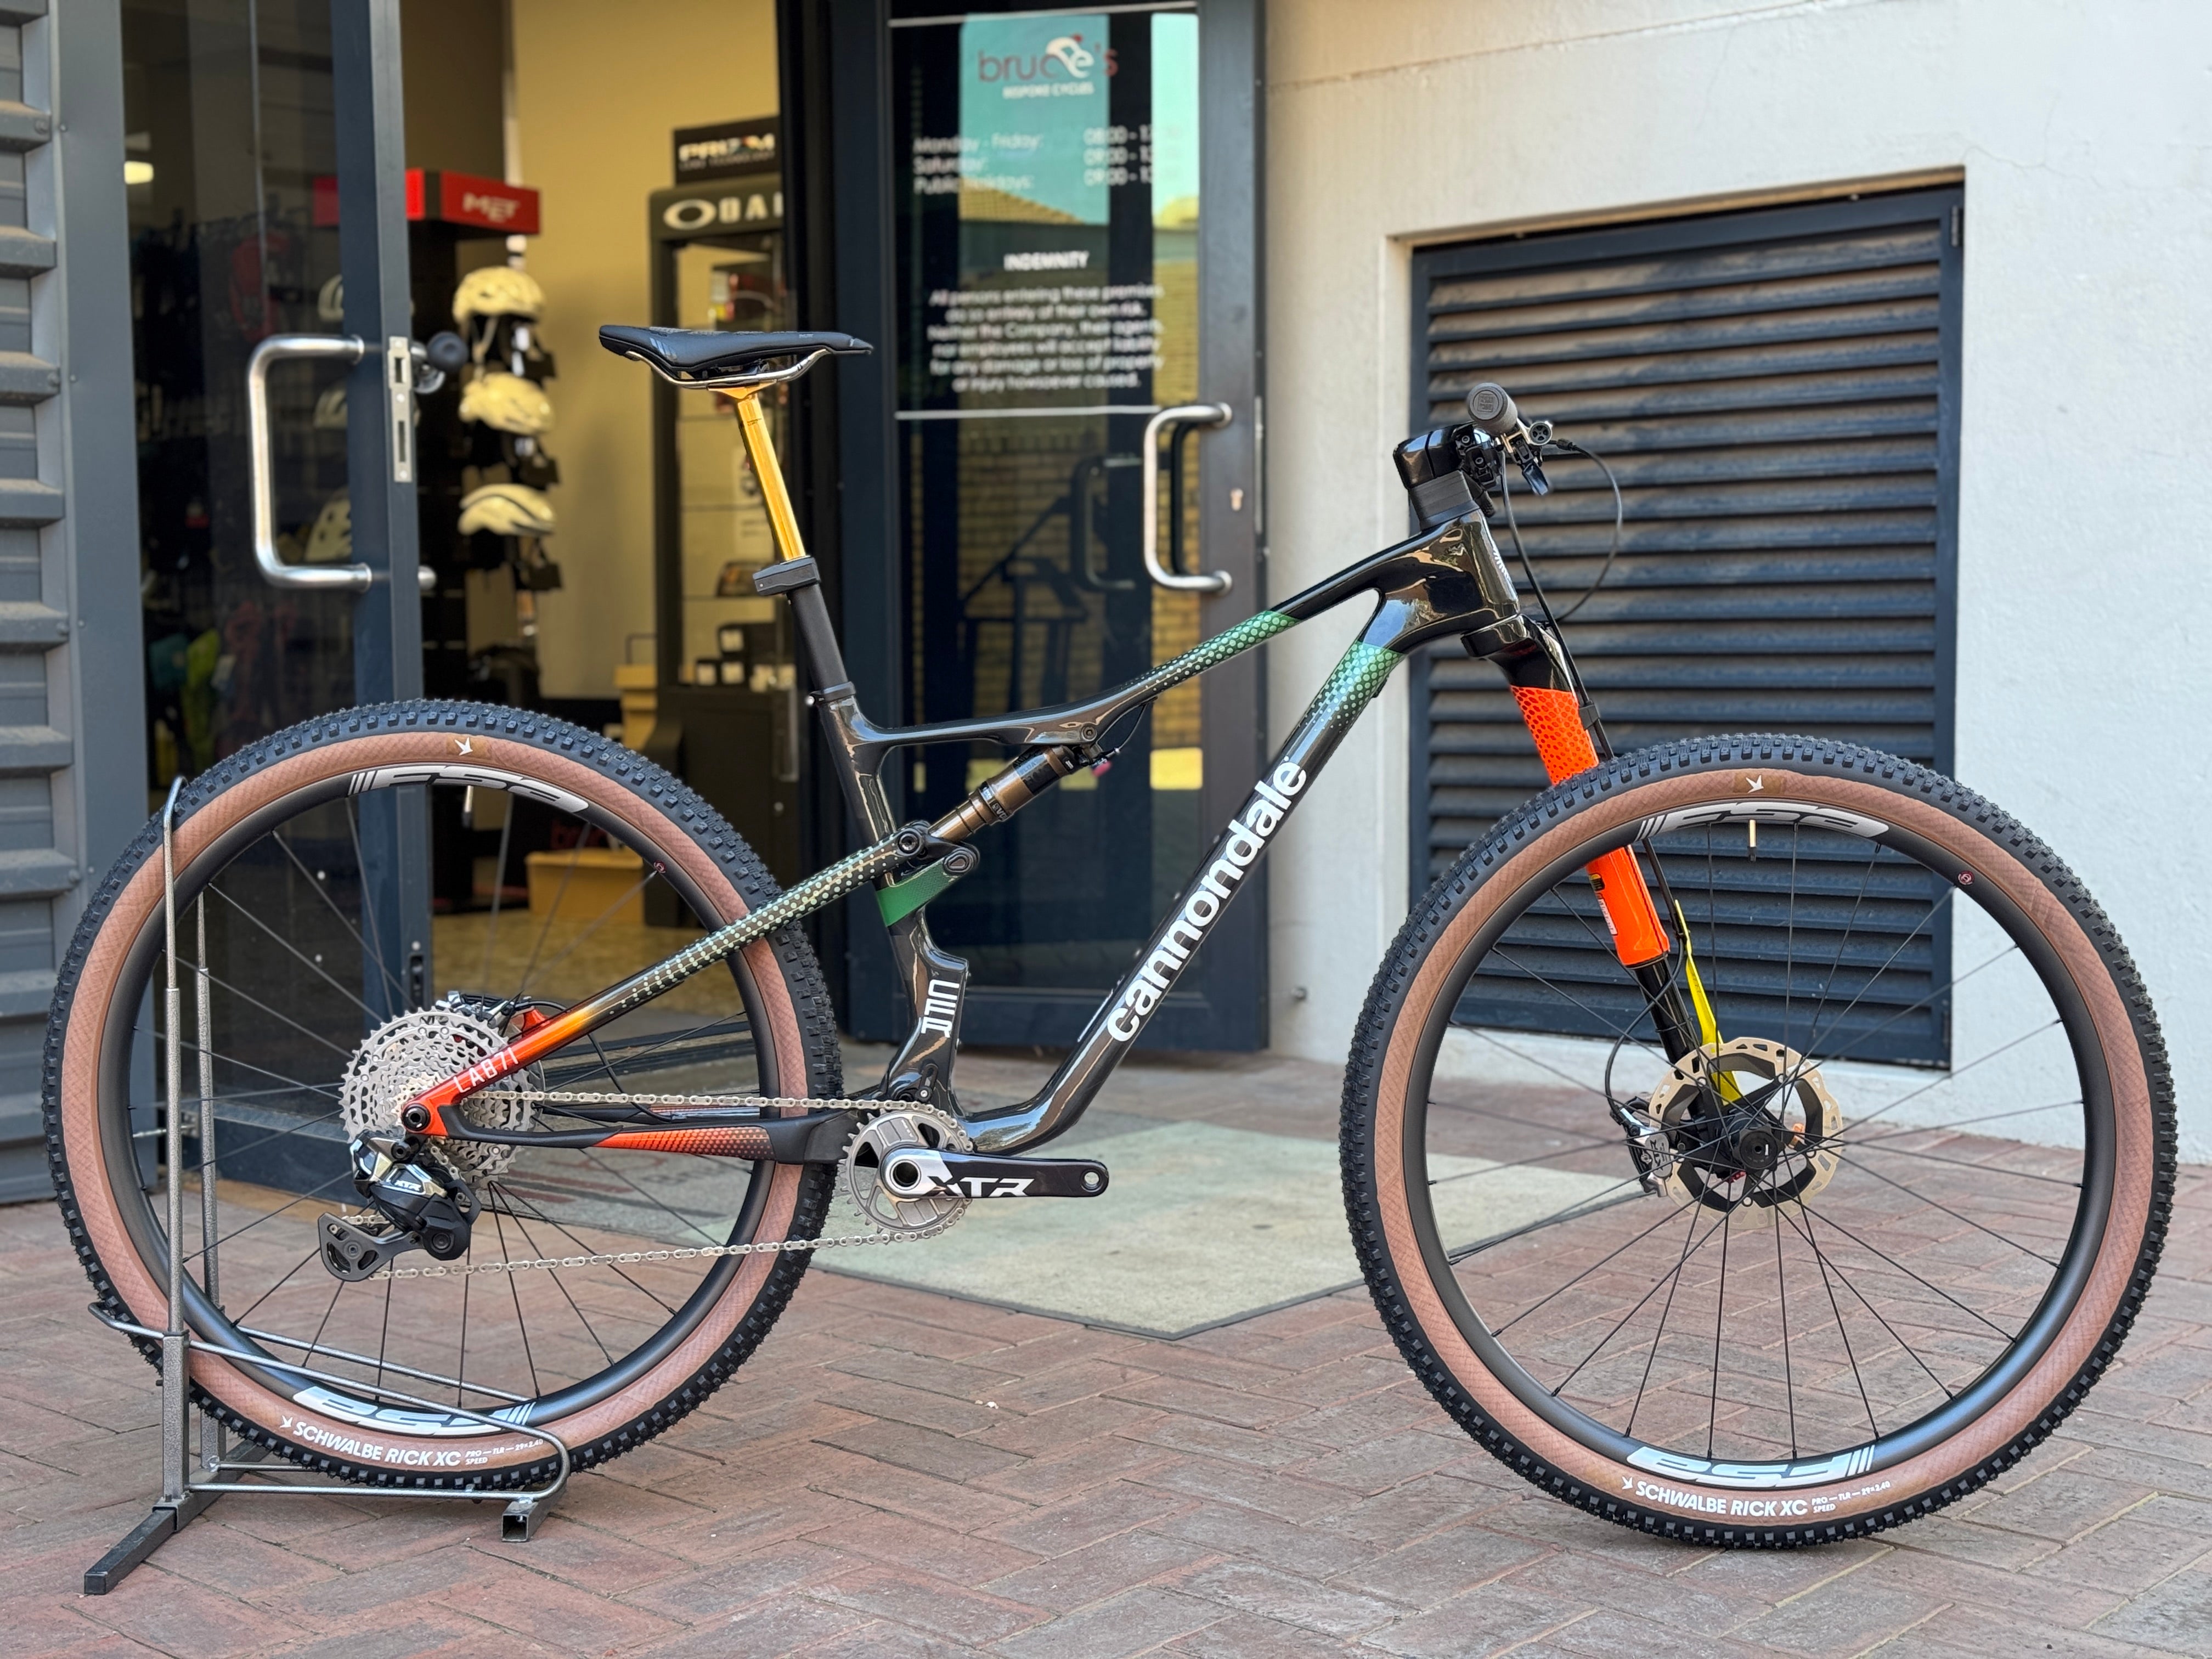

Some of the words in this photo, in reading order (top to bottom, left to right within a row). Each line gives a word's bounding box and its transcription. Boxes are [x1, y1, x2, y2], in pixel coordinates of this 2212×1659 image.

[1003, 250, 1090, 271] INDEMNITY
[1107, 761, 1307, 1042] cannondale
[292, 1421, 383, 1460] SCHWALBE
[387, 1447, 433, 1466] RICK
[437, 1451, 462, 1467] XC
[465, 1457, 488, 1465] SPEED
[1636, 1481, 1726, 1515] SCHWALBE
[1730, 1499, 1778, 1516] RICK
[1779, 1499, 1808, 1516] XC
[1812, 1497, 1829, 1506] PRO
[1813, 1503, 1836, 1514] SPEED
